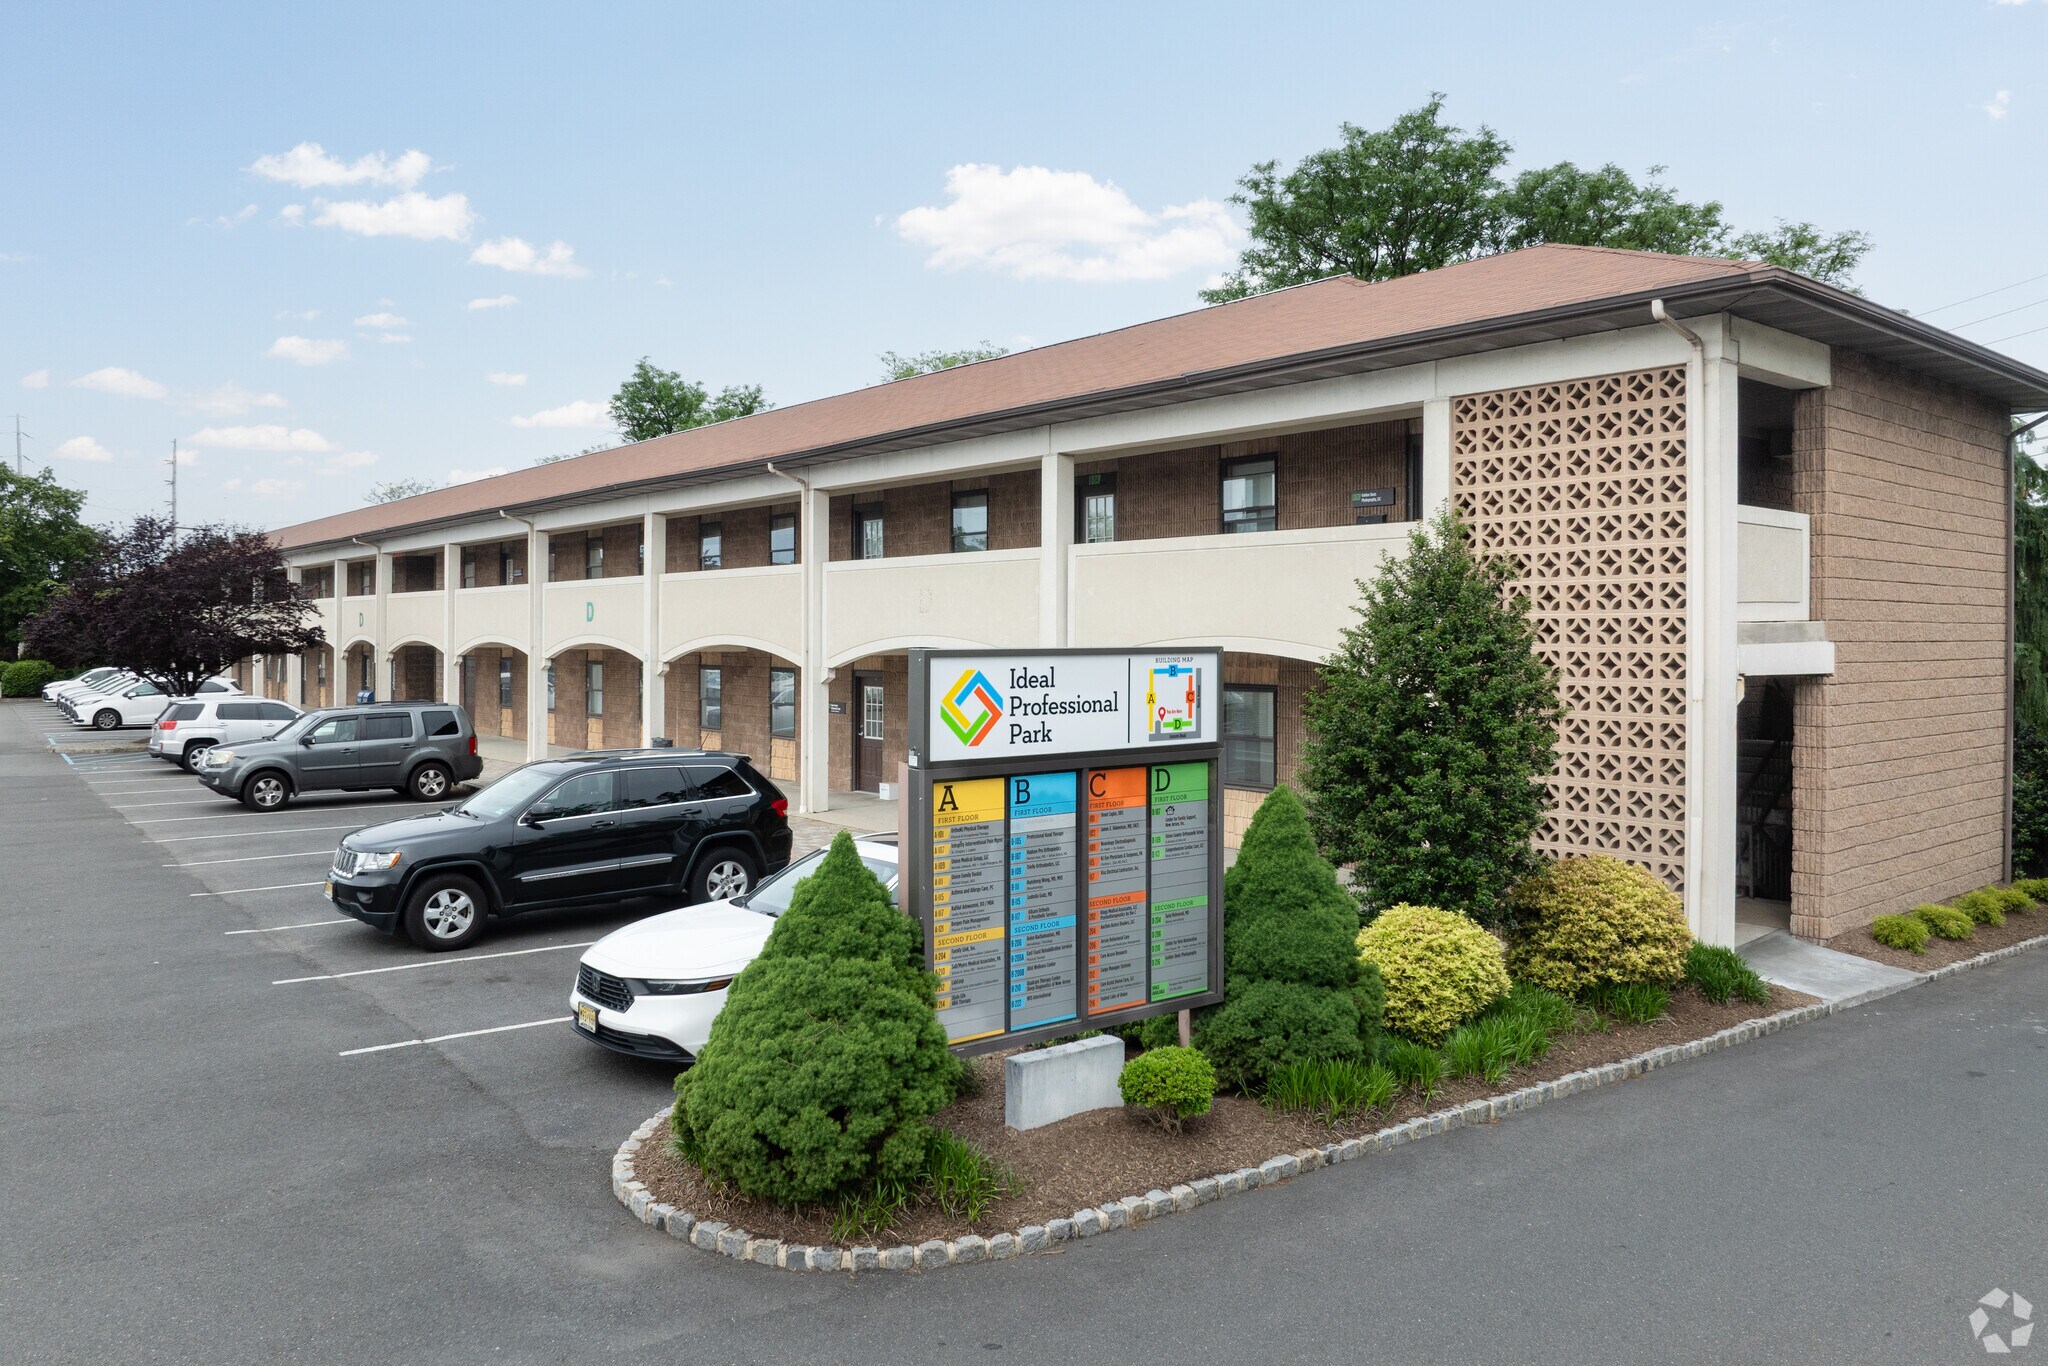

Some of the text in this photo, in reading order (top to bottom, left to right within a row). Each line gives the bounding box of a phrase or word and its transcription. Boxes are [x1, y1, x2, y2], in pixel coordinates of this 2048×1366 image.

[359, 612, 364, 628] D
[586, 602, 594, 622] D
[1010, 666, 1056, 690] Ideal
[1170, 666, 1176, 676] B
[1010, 691, 1119, 717] Professional
[1148, 694, 1154, 703] A
[1187, 692, 1194, 702] C
[1174, 719, 1181, 729] D
[1009, 721, 1053, 745] Park
[1090, 773, 1106, 797] C
[1155, 768, 1170, 792] D
[938, 785, 959, 812] A
[1015, 779, 1030, 805] B
[1090, 899, 1112, 907] SECOND
[1154, 903, 1175, 912] SECOND
[1014, 925, 1039, 934] SECOND
[938, 933, 986, 946] SECOND FLOOR
